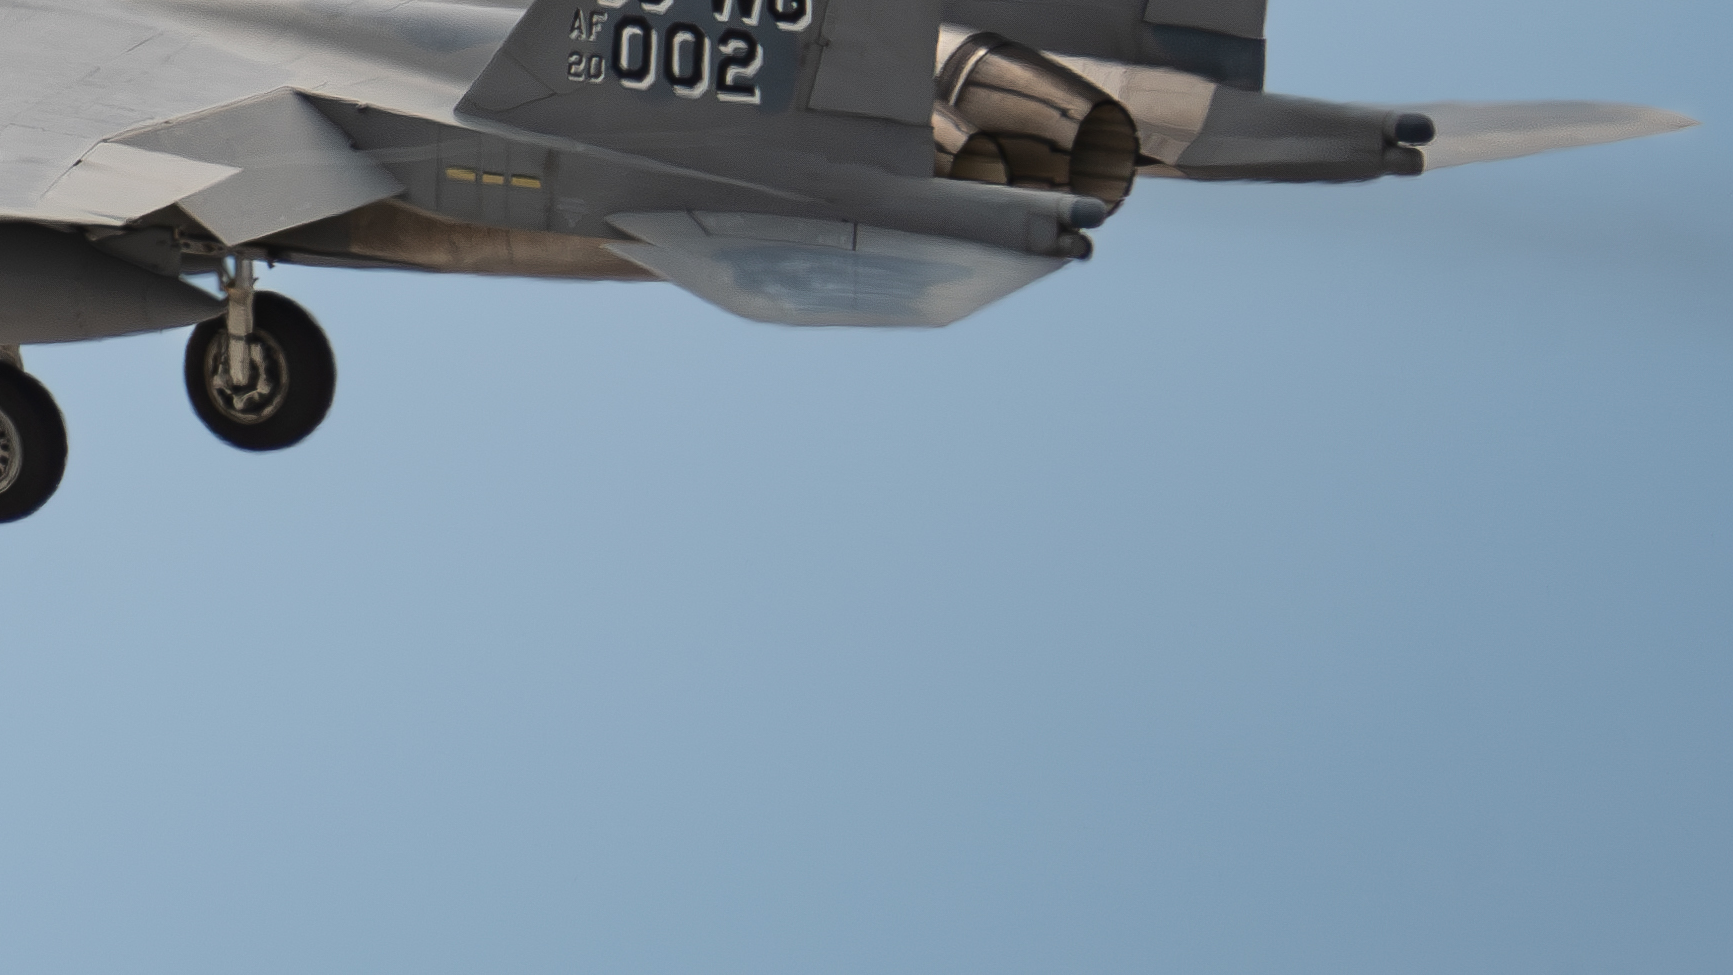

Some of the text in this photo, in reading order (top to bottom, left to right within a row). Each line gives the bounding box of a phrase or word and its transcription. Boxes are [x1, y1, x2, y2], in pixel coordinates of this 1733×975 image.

[569, 7, 609, 42] AF
[568, 50, 606, 83] 20
[611, 14, 764, 105] 002
